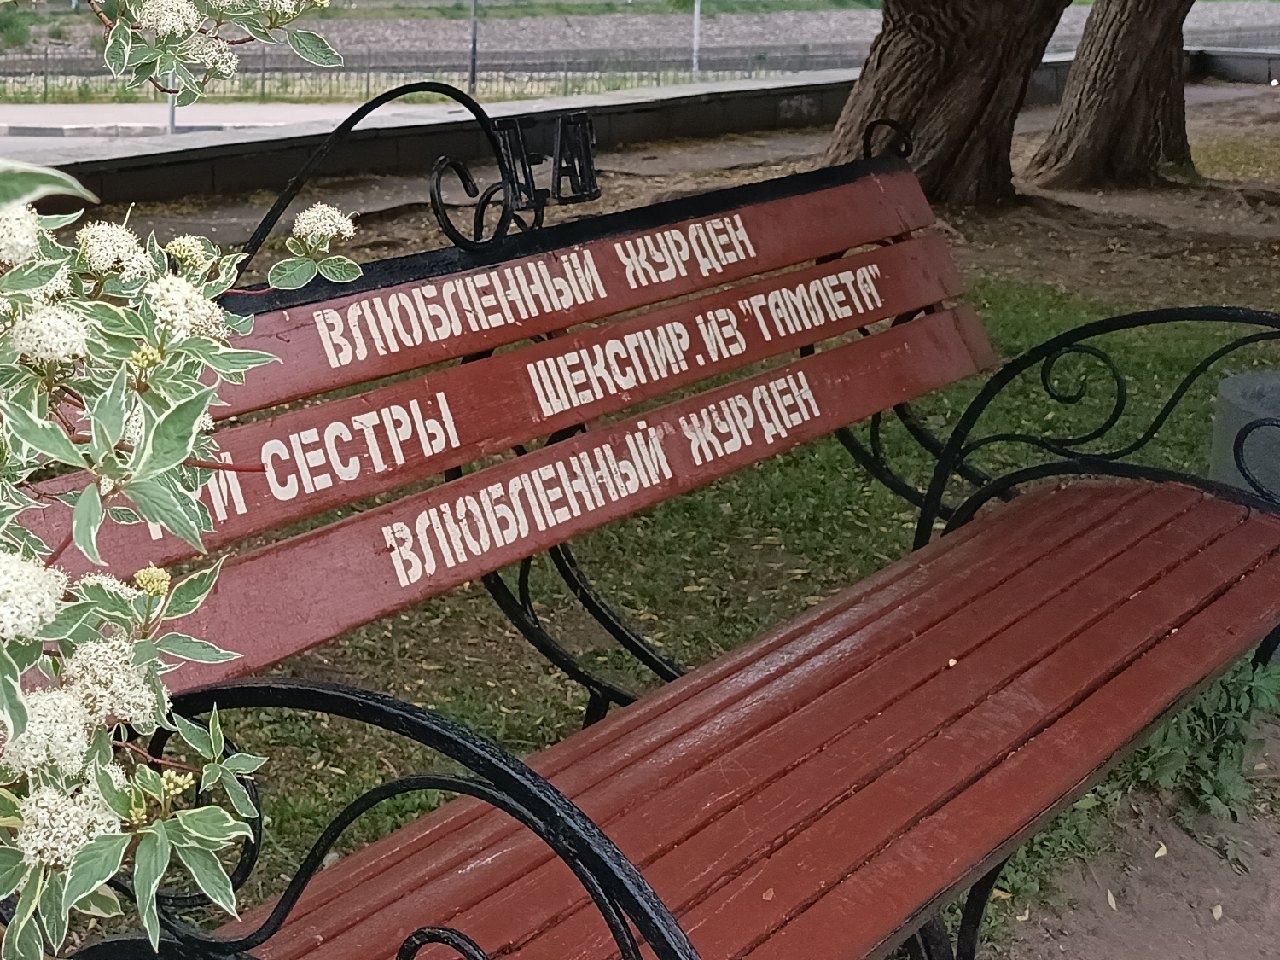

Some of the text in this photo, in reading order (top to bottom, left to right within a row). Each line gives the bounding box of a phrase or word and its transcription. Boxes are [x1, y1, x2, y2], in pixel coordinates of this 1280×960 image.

[312, 214, 757, 368] ВЛЮБЛЕННЫЙ ЖУРДЕН
[261, 392, 461, 501] СЕСТРЫ
[381, 421, 673, 587] ВЛЮБЛЕННЫЙ
[679, 371, 821, 465] ЖУРДЕН
